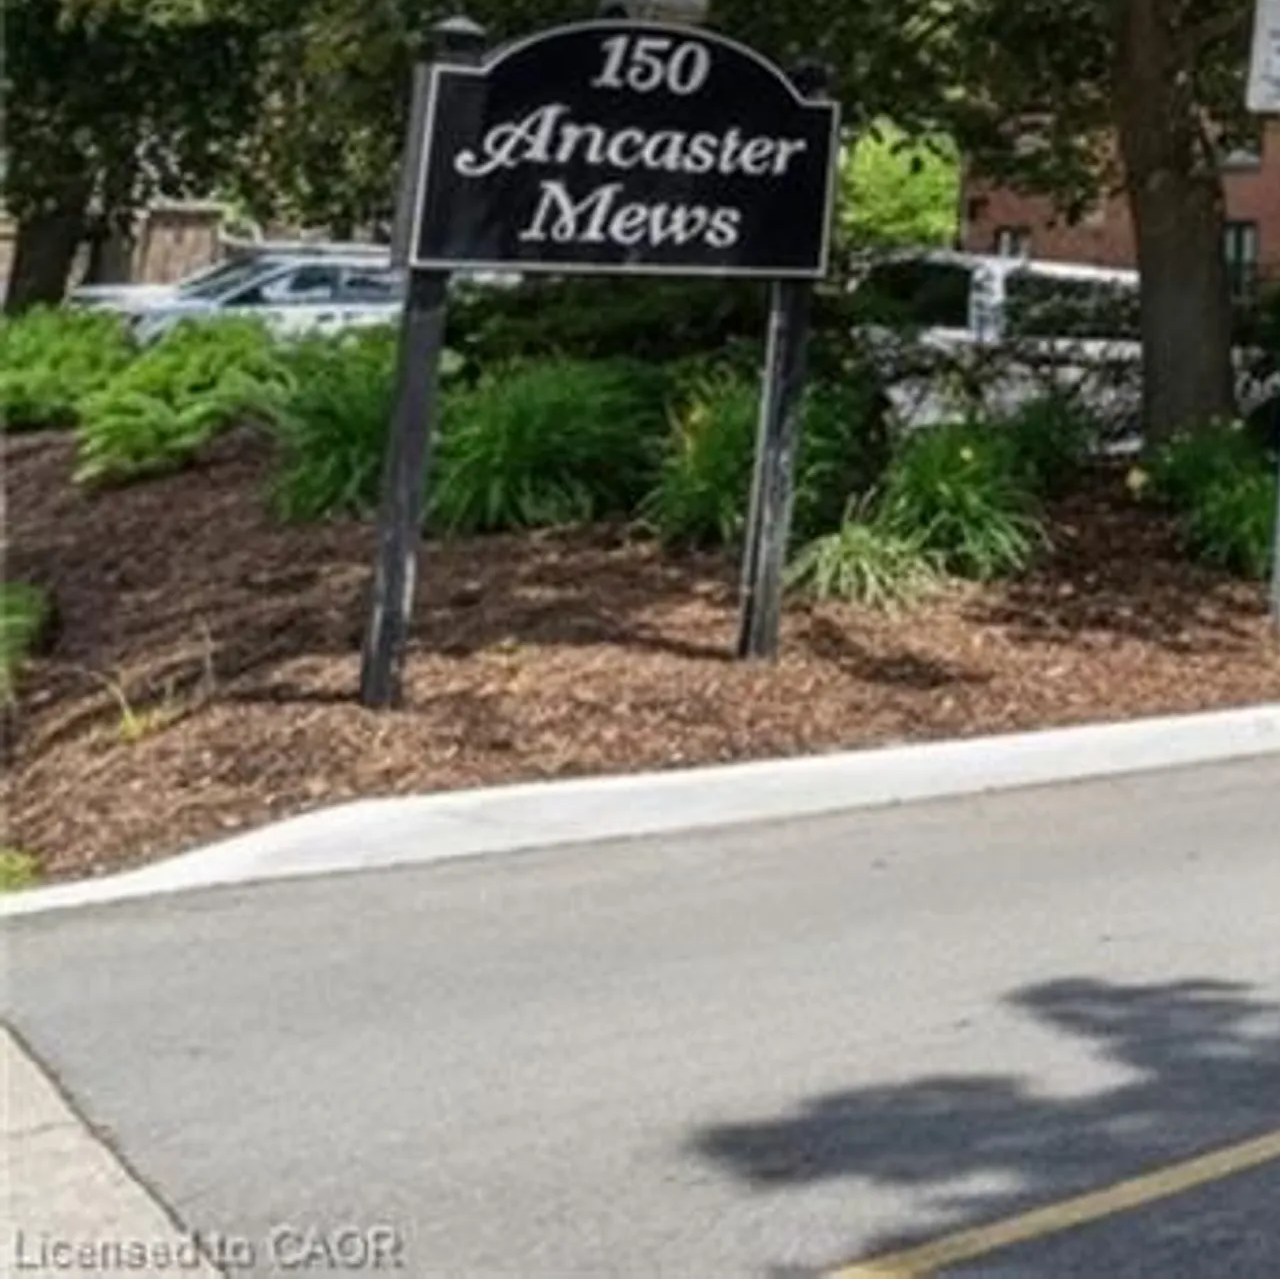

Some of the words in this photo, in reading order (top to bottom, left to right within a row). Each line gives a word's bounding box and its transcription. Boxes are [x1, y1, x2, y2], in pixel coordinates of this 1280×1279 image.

[590, 33, 711, 95] 150
[453, 103, 807, 178] Ancaster
[518, 179, 742, 249] Mews
